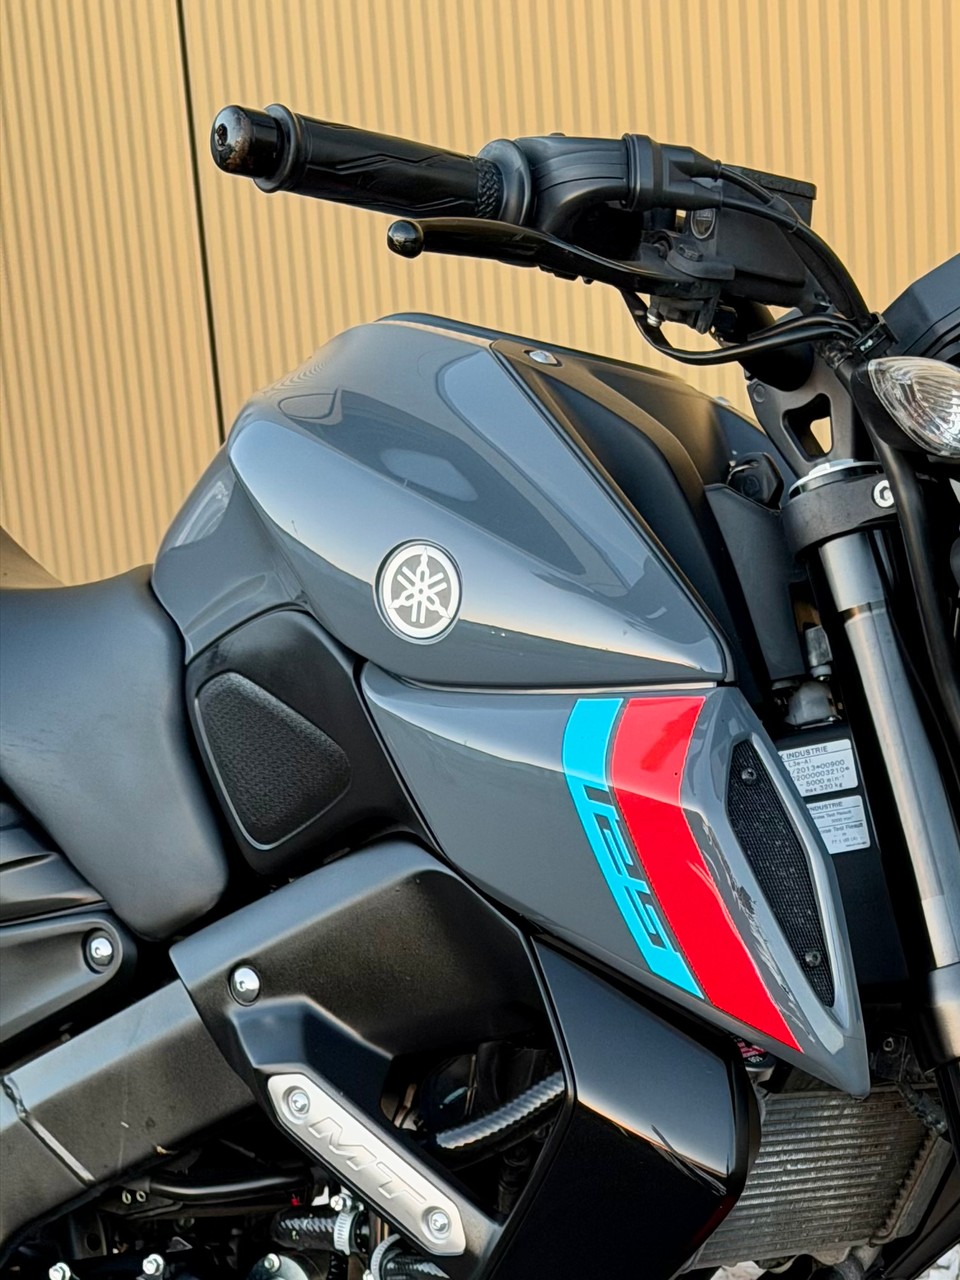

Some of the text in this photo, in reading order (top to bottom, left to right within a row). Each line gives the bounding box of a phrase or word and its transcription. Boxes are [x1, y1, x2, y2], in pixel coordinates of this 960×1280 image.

[786, 745, 828, 759] INDUSTRIE
[806, 777, 825, 787] 5000
[820, 783, 833, 791] 320
[810, 801, 843, 811] NDUSTRIE
[583, 784, 675, 952] 125
[308, 1116, 428, 1201] MT
